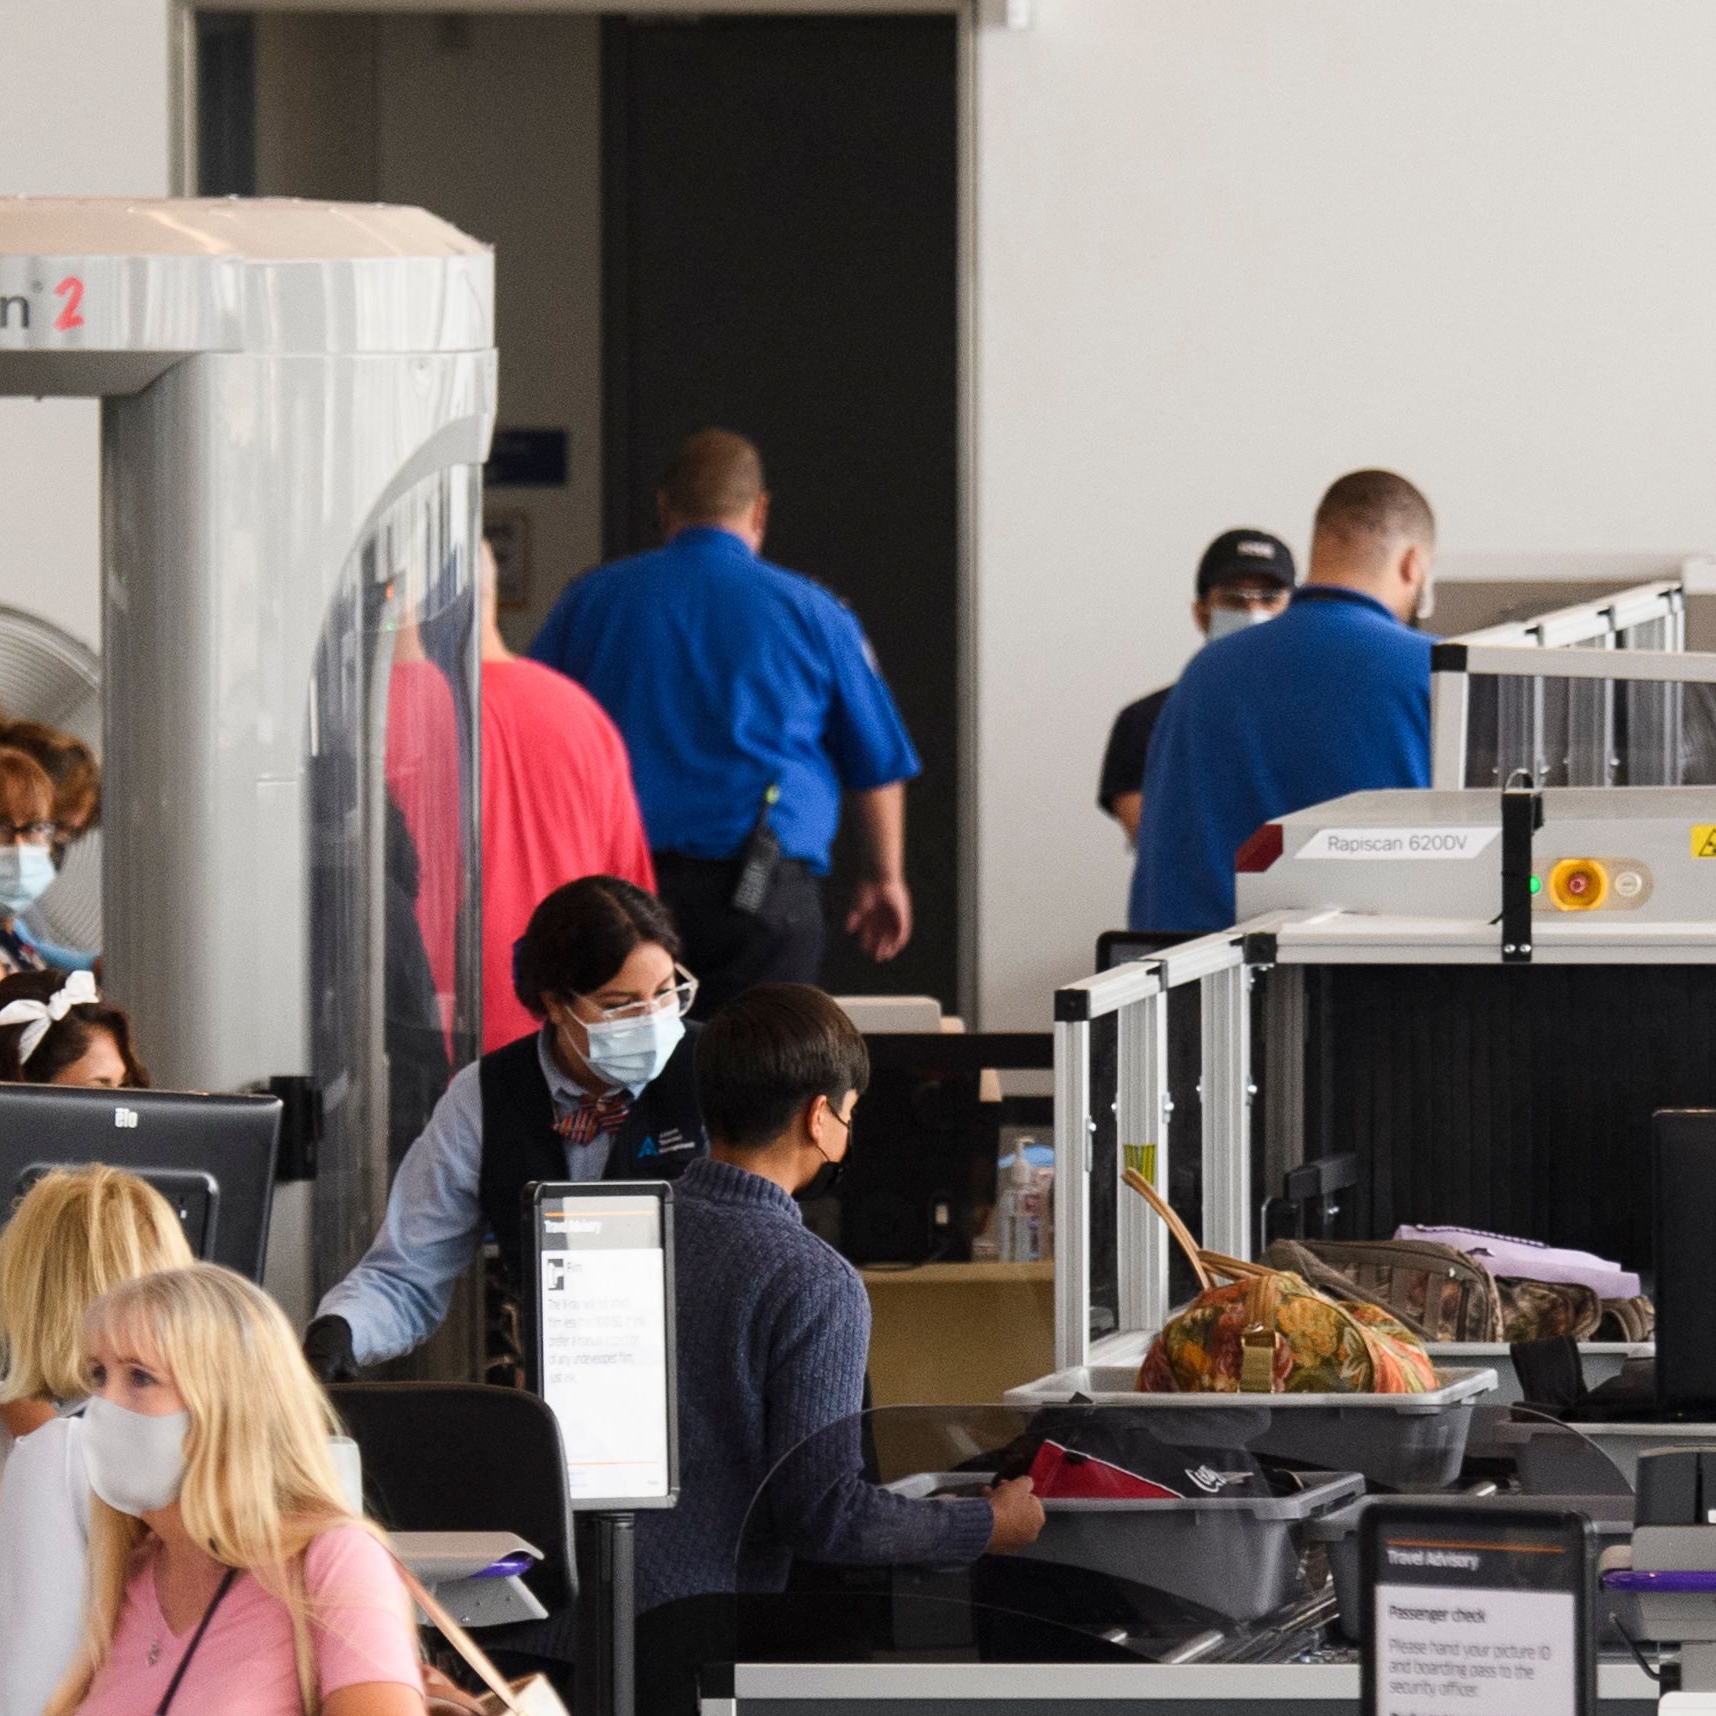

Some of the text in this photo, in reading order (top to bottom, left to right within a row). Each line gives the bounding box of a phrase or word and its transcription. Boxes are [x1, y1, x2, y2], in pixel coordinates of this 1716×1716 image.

[52, 274, 86, 332] 2
[1327, 835, 1467, 853] Rapiscan 620DV
[1386, 1549, 1480, 1571] Travel Advisory
[1389, 1604, 1487, 1624] Passenger check
[1389, 1637, 1428, 1654] Please
[1430, 1639, 1460, 1655] hand
[1462, 1643, 1493, 1661] your
[1494, 1641, 1535, 1661] picture
[1389, 1660, 1535, 1681] and boarding pass to the
[1389, 1680, 1436, 1698] security
